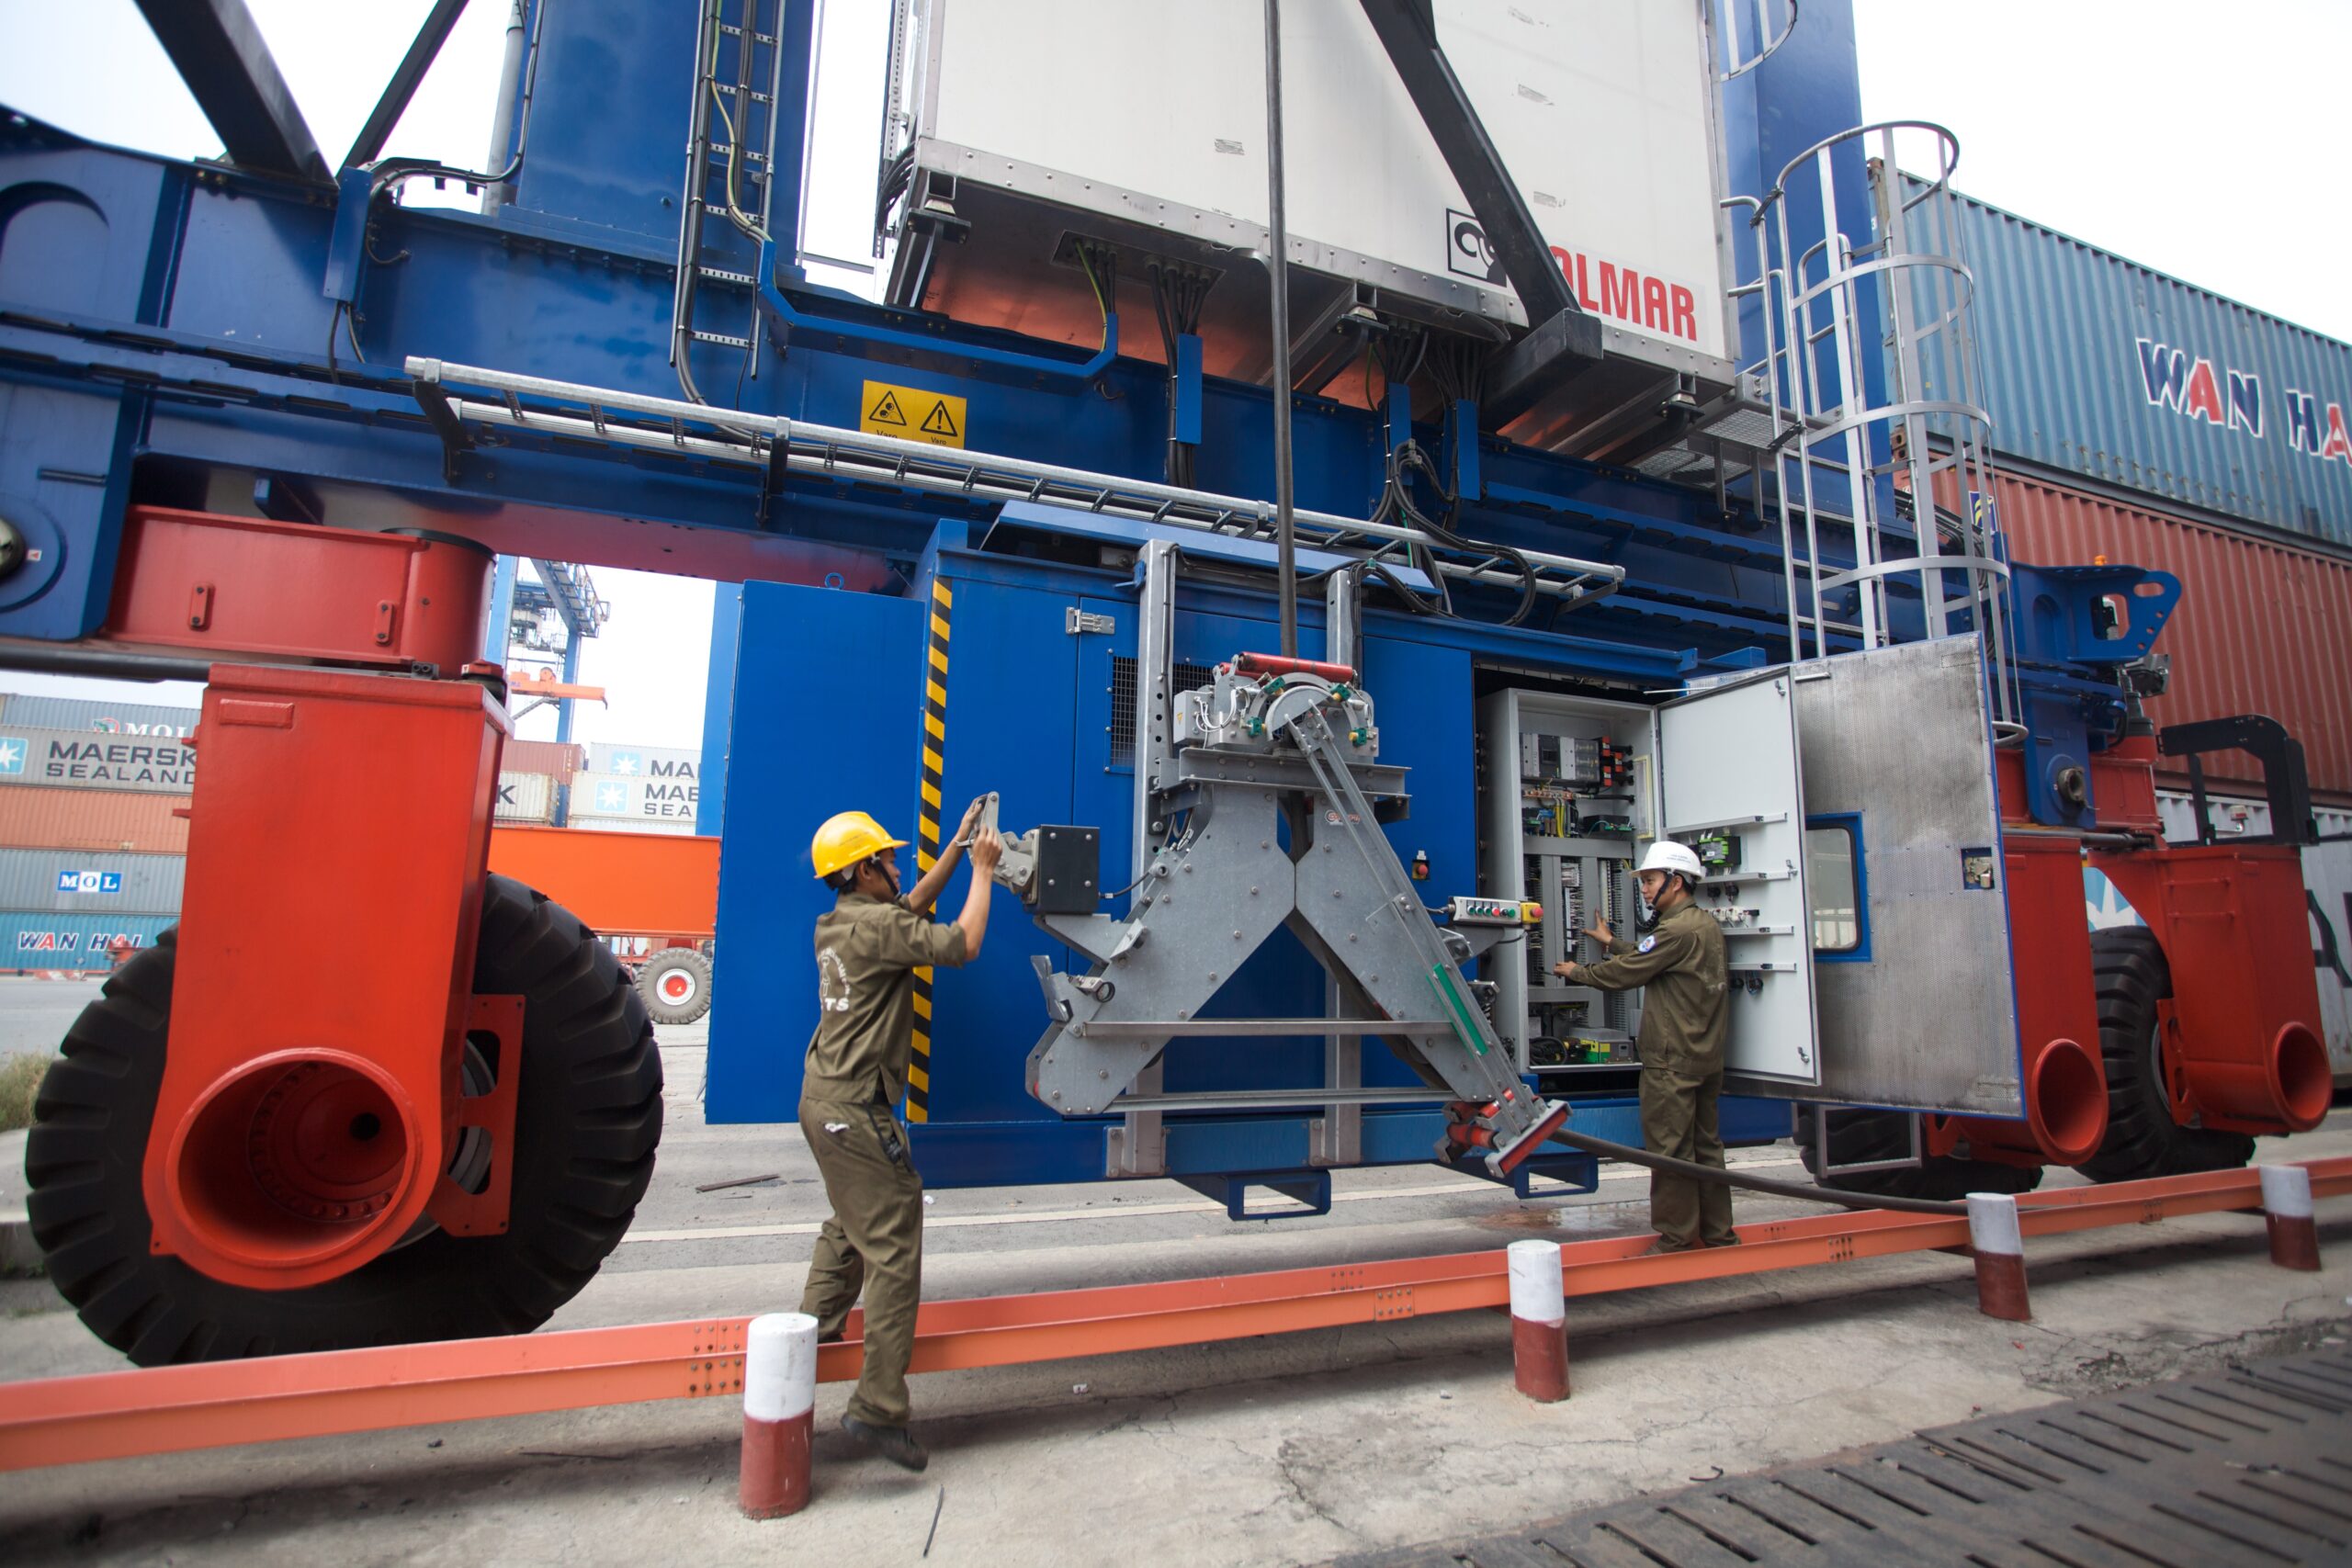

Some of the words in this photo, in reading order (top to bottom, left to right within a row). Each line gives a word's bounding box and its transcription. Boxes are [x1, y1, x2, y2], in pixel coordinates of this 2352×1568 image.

[2135, 336, 2264, 439] WAN
[2285, 389, 2352, 468] HA
[49, 740, 197, 767] MAERSK
[650, 760, 701, 779] MA
[644, 803, 692, 817] SEA
[59, 874, 119, 891] MOL
[17, 931, 79, 951] WAN
[820, 998, 850, 1012] TS
